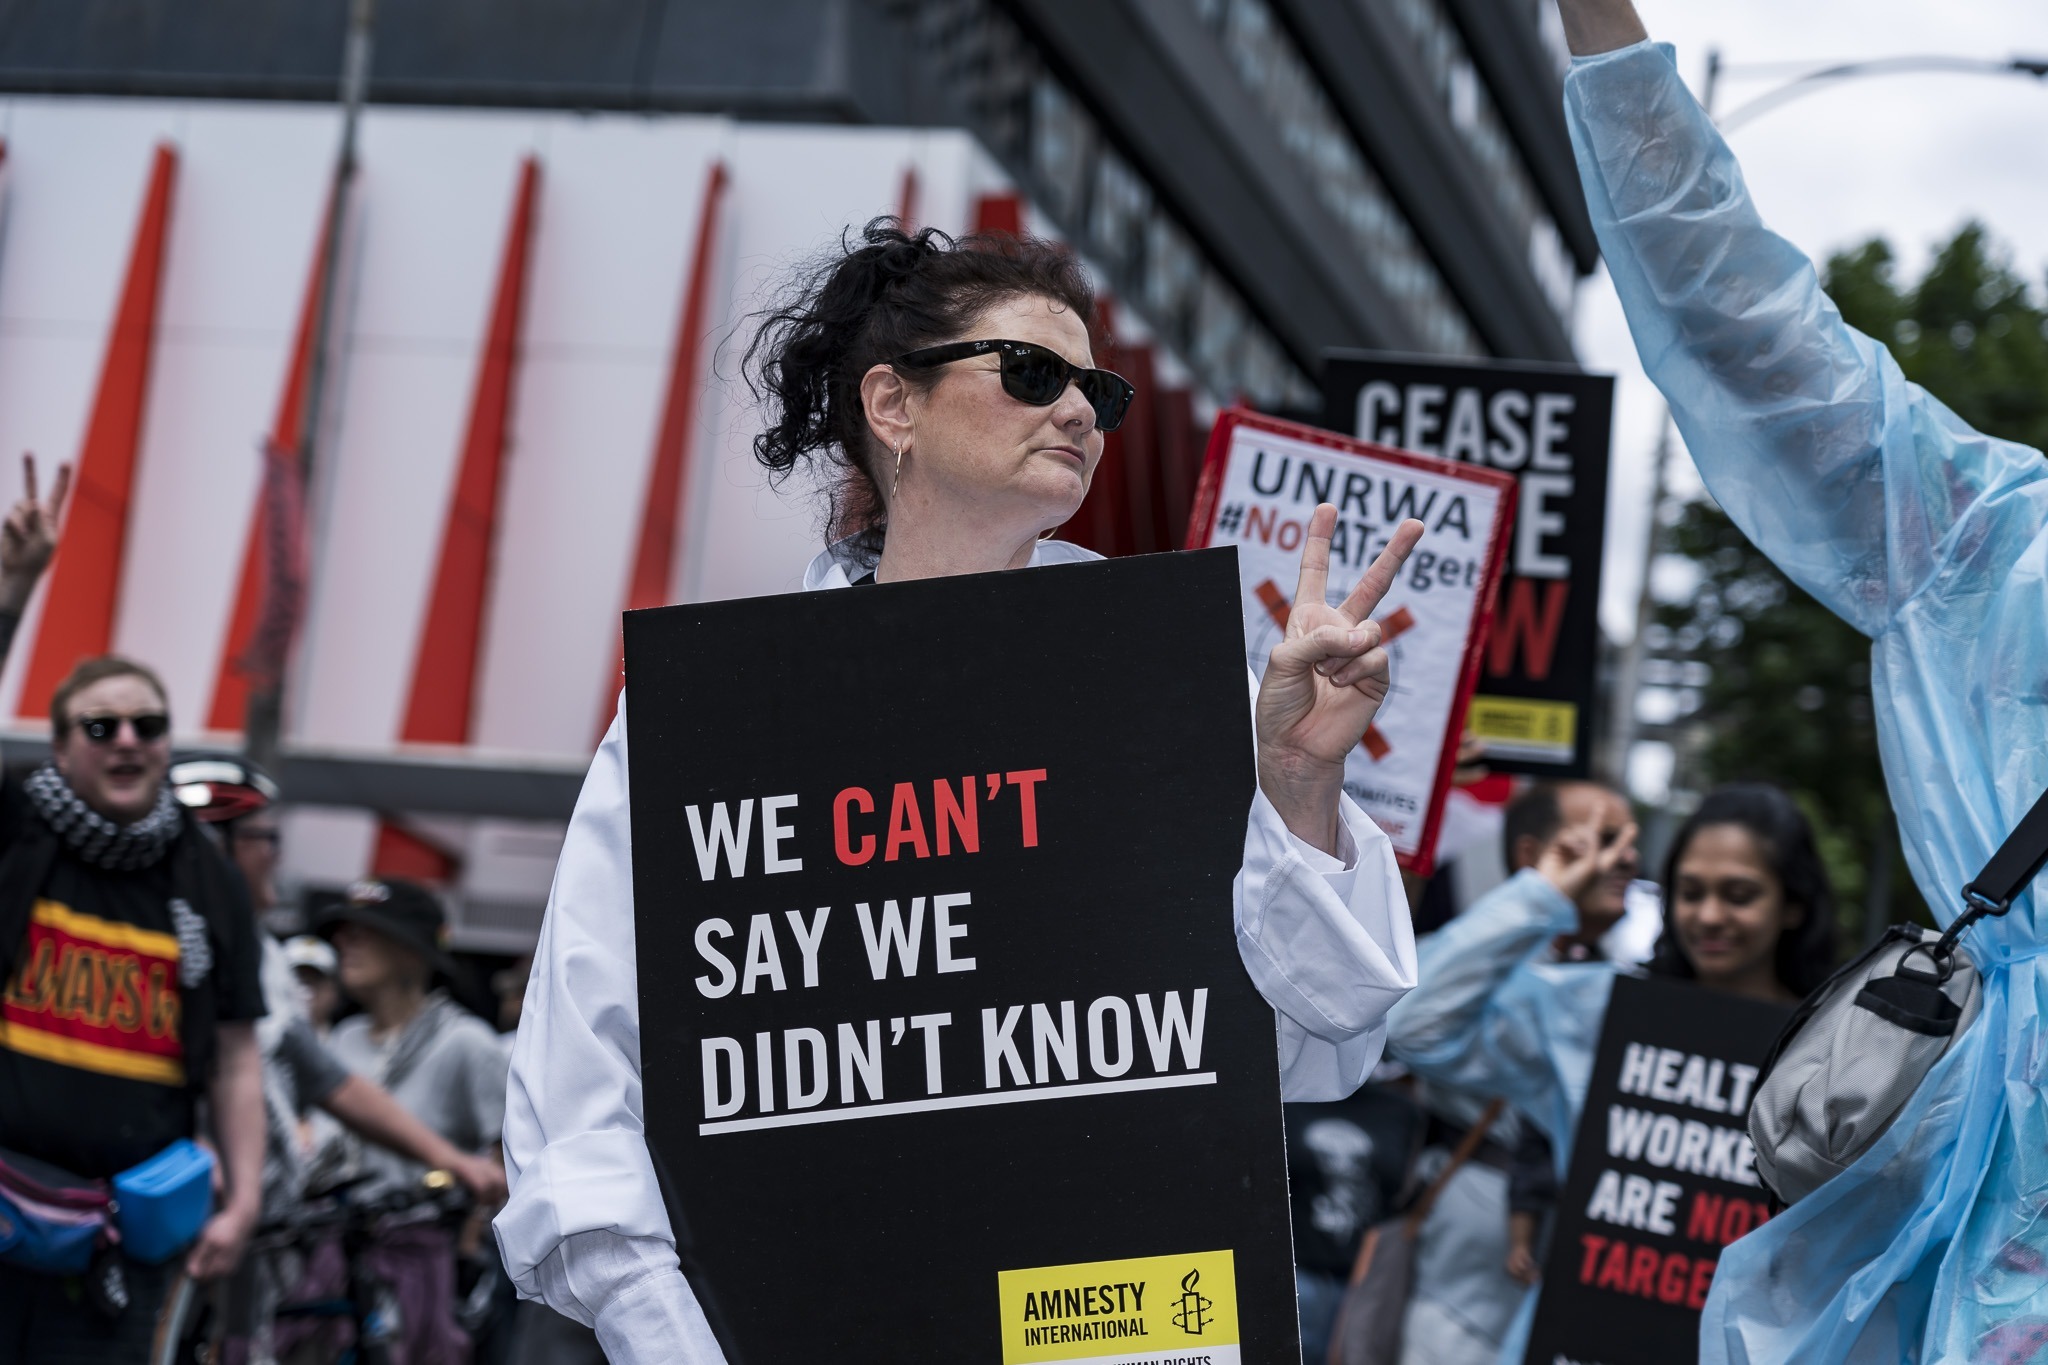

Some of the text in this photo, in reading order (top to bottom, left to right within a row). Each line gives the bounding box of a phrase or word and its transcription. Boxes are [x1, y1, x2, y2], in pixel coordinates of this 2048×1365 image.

[1355, 379, 1576, 471] CEASE
[1251, 450, 1471, 539] UNRWA
[1217, 502, 1480, 593] #NoATaget
[685, 768, 1047, 881] WE CAN'T
[694, 892, 976, 999] SAY WE
[701, 987, 1209, 1119] DIDN'T KNOW
[1618, 1042, 1757, 1116] HEALT
[1607, 1105, 1764, 1188] WORKE
[1587, 1170, 1682, 1236] ARE
[1024, 1282, 1146, 1322] AMNESTY
[1579, 1234, 1716, 1310] TARGE
[1024, 1318, 1148, 1346] INTERNATIONAL
